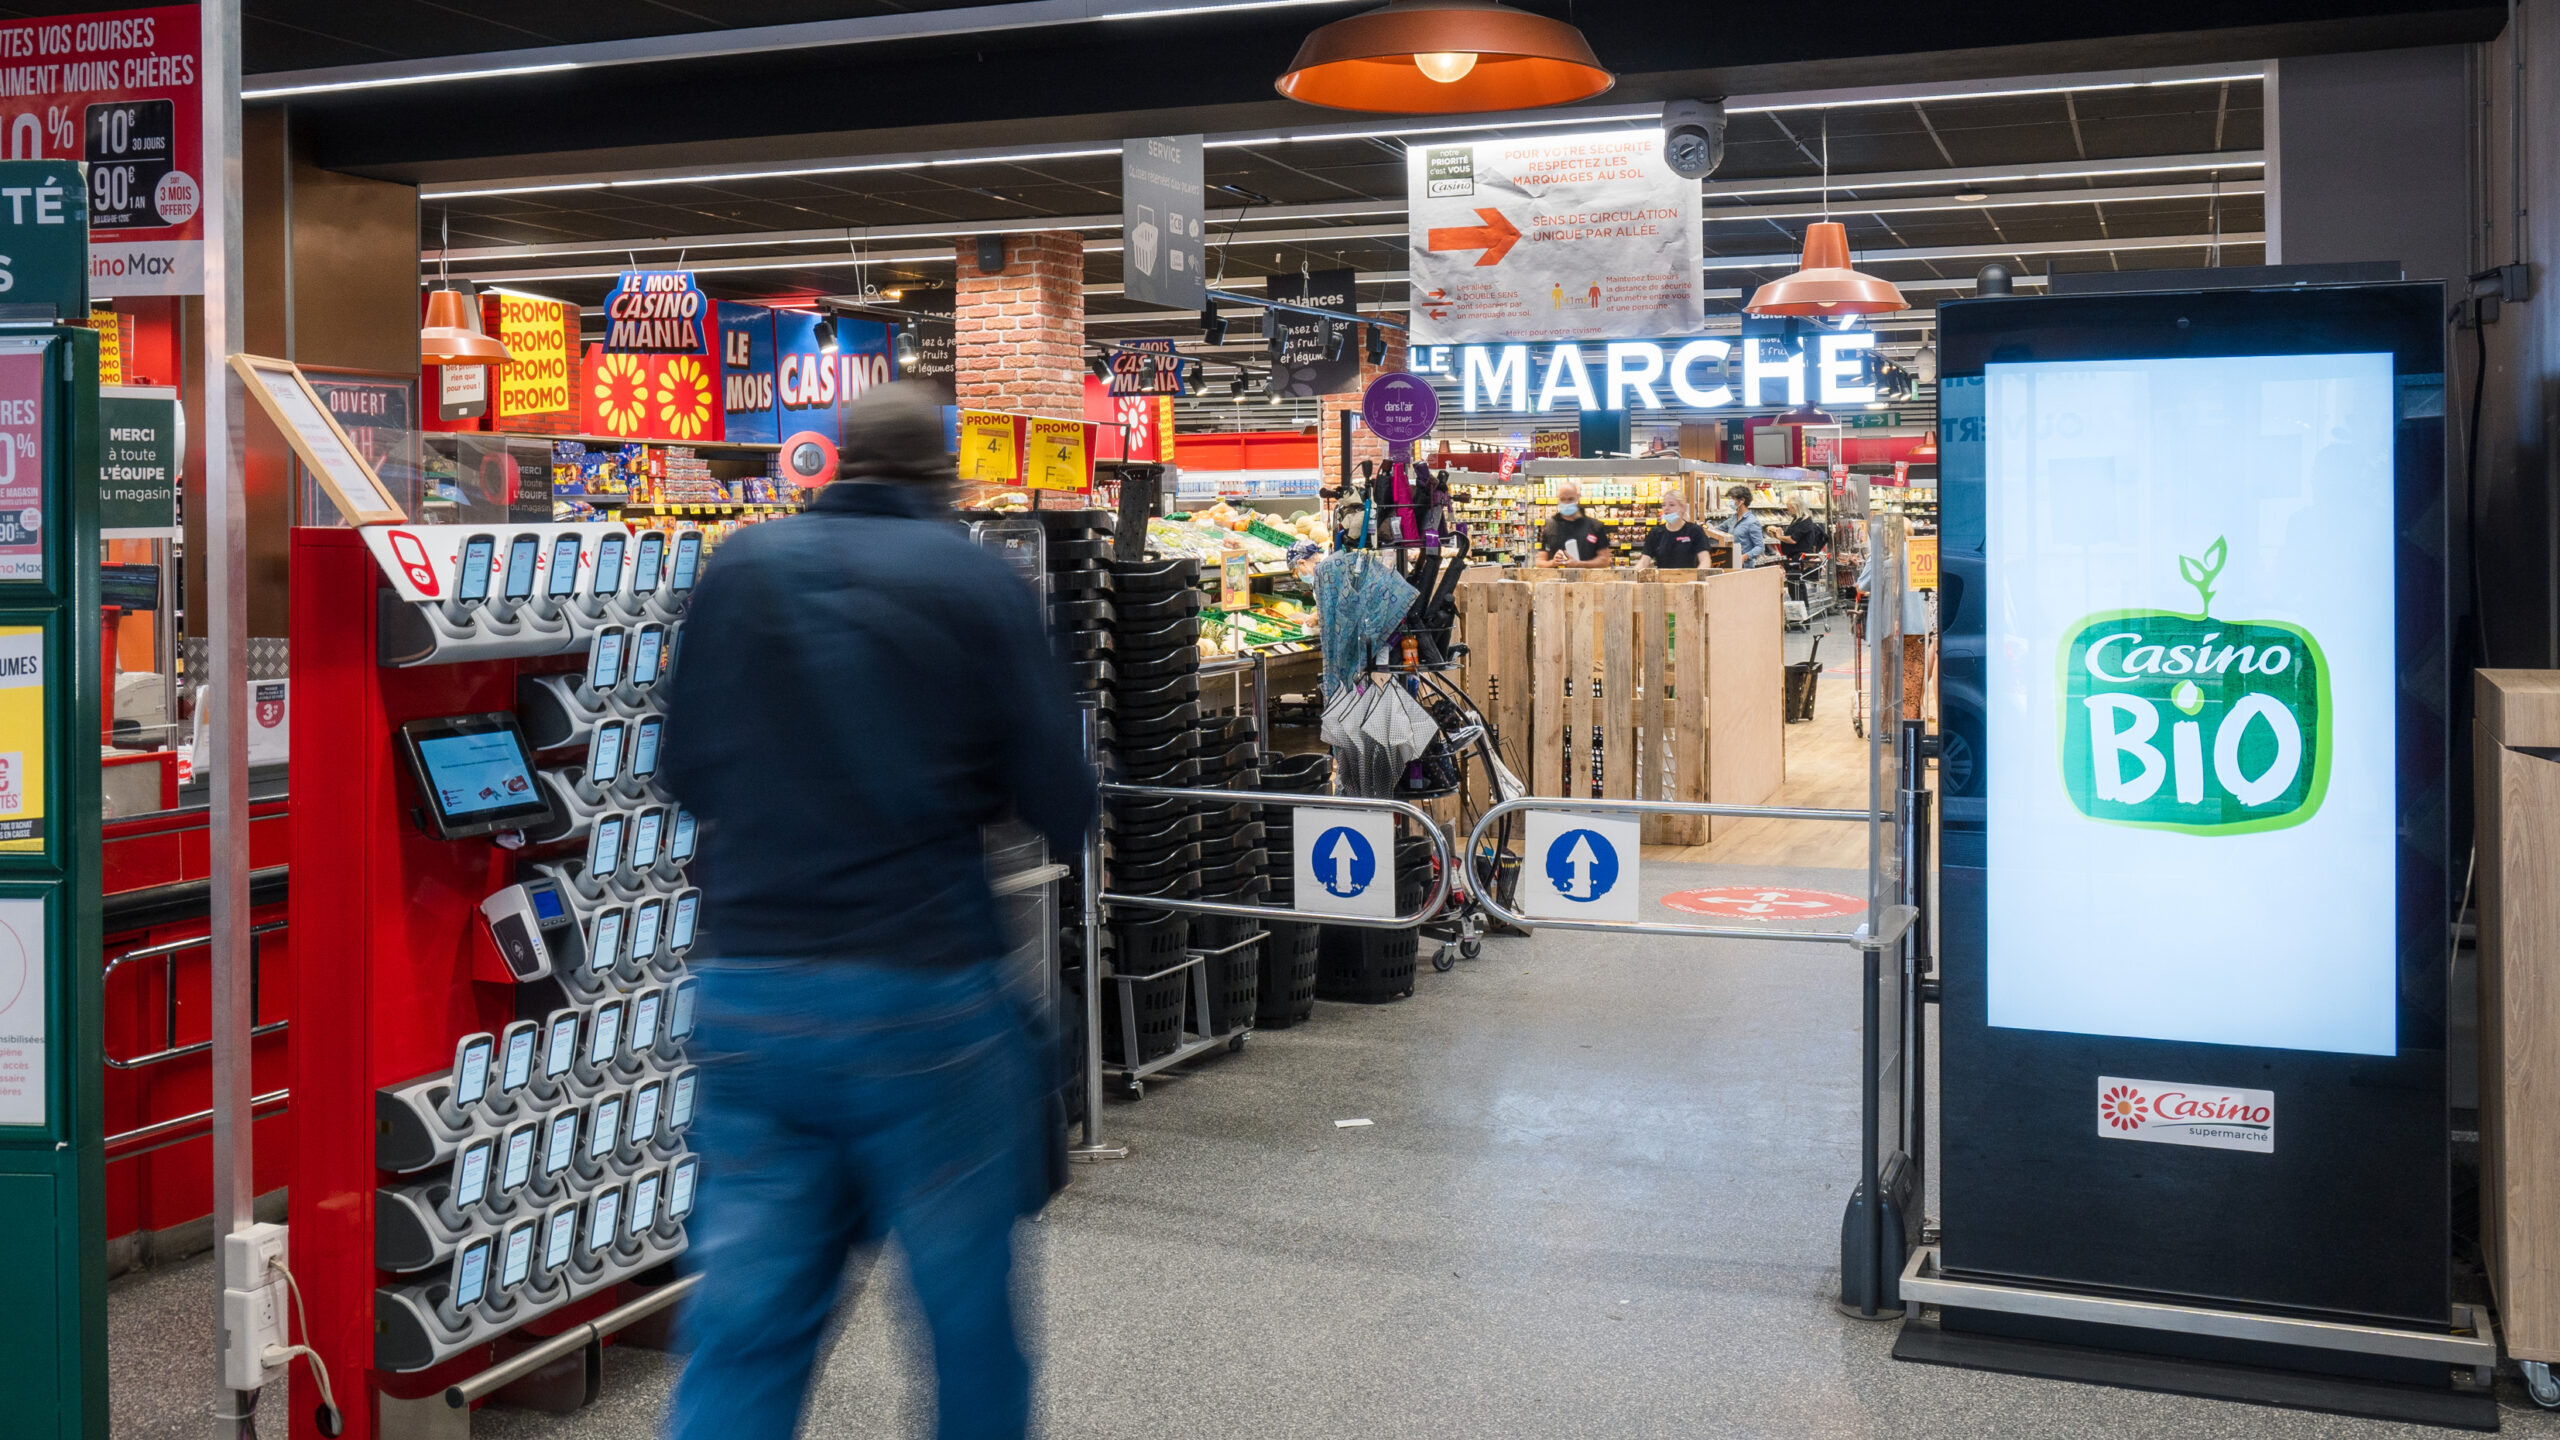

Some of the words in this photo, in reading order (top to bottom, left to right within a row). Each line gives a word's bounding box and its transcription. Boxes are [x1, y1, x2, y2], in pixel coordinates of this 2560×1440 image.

[0, 27, 34, 58] TES
[39, 24, 72, 55] VOS
[76, 17, 155, 51] COURSES
[63, 61, 119, 93] MOINS
[124, 52, 194, 88] CHÈRES
[143, 137, 166, 149] JOURS
[1148, 140, 1181, 164] SERVICE
[1504, 150, 1539, 161] POUR
[1543, 146, 1586, 159] VOTRE
[1431, 156, 1469, 166] PRIORITÉ
[1528, 159, 1600, 172] RESPECTEZ
[1604, 157, 1628, 168] LES
[1447, 165, 1471, 174] VOUS
[1512, 173, 1593, 187] MARQUAGES
[1598, 171, 1617, 181] AU
[1619, 169, 1645, 179] SOL
[160, 189, 166, 200] 3
[168, 186, 192, 200] MOIS
[1431, 181, 1472, 193] Casino
[2, 176, 65, 225] TÉ
[134, 196, 146, 208] AN
[160, 203, 192, 216] OFFERTS
[1532, 216, 1566, 227] SENS
[1568, 214, 1586, 225] DE
[1589, 208, 1679, 224] CIRCULATION
[1532, 228, 1582, 242] UNIQUE
[1586, 228, 1608, 239] PAR
[1615, 223, 1660, 237] ALLÉE.
[622, 275, 642, 292] LE
[644, 274, 687, 292] MOIS
[1605, 275, 1645, 284] Maintenez
[1647, 273, 1680, 284] toujours
[1615, 282, 1647, 291] distance
[1650, 282, 1659, 290] de
[1662, 281, 1693, 291] sécurité
[1456, 284, 1470, 292] Les
[1463, 291, 1494, 300] DOUBLE
[1497, 291, 1518, 299] SENS
[1648, 292, 1668, 300] entre
[501, 302, 561, 323] PROMO
[610, 293, 698, 319] CASINO
[1456, 302, 1474, 310] sont
[1515, 301, 1523, 309] par
[1605, 304, 1614, 312] et
[1470, 312, 1506, 321] marquage
[609, 322, 699, 349] MANIA
[1505, 329, 1528, 338] Merci
[1529, 328, 1547, 338] pour
[1550, 327, 1570, 336] votre
[1572, 325, 1602, 335] civisme
[501, 330, 563, 351] PROMO
[727, 330, 751, 366] LE
[922, 350, 948, 360] fruits
[1280, 354, 1290, 363] et
[1409, 346, 1450, 373] LE
[1462, 312, 1876, 412] MARCHÉ
[502, 359, 564, 382] PROMO
[907, 365, 915, 373] et
[918, 363, 955, 376] légumes
[1113, 355, 1179, 373] CASNO
[447, 385, 461, 393] pour
[1113, 372, 1180, 392] MAIA
[504, 386, 565, 411] PROMO
[726, 376, 773, 411] MOIS
[329, 390, 387, 414] OUVERT
[966, 415, 1010, 425] PROMO
[110, 428, 155, 441] MERCI
[1035, 423, 1080, 433] PROMO
[108, 448, 117, 461] à
[121, 449, 156, 461] toute
[798, 451, 819, 470] 10
[6, 487, 38, 497] MAGASIN
[115, 486, 170, 501] magasin
[523, 505, 550, 516] magasin
[2084, 632, 2292, 683] Casino
[0, 656, 37, 676] UMES
[2153, 1092, 2271, 1123] Casino
[2189, 1126, 2269, 1142] supermarché
